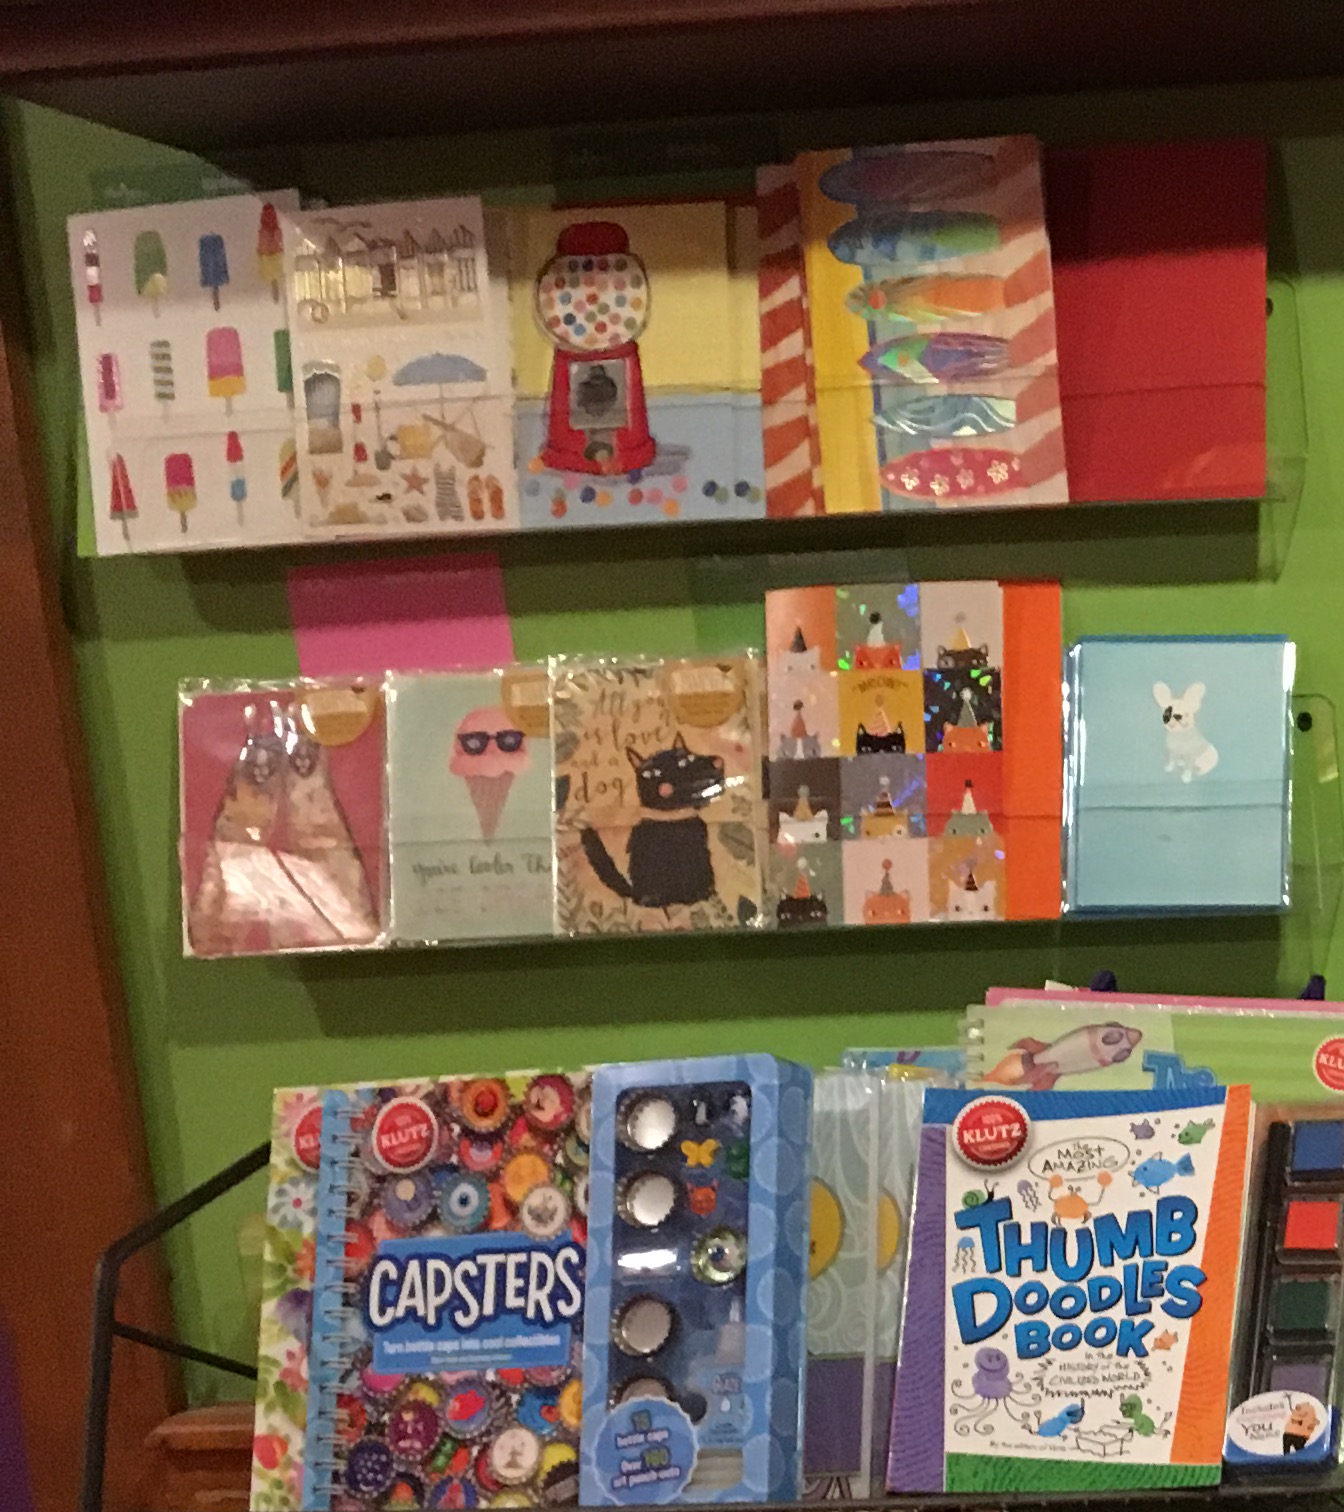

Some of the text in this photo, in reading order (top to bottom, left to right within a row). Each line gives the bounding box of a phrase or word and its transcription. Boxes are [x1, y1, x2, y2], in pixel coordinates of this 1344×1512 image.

[574, 771, 627, 809] dog
[381, 1123, 428, 1150] KLUTZ
[962, 1120, 1023, 1147] KLUTZ
[1042, 1155, 1119, 1174] AMAZING
[954, 1194, 1199, 1281] THUMB
[368, 1245, 582, 1328] CAPSTERS
[951, 1260, 1208, 1345] DOODLES
[1014, 1318, 1156, 1360] BOOK
[1240, 1422, 1273, 1436] YOU
